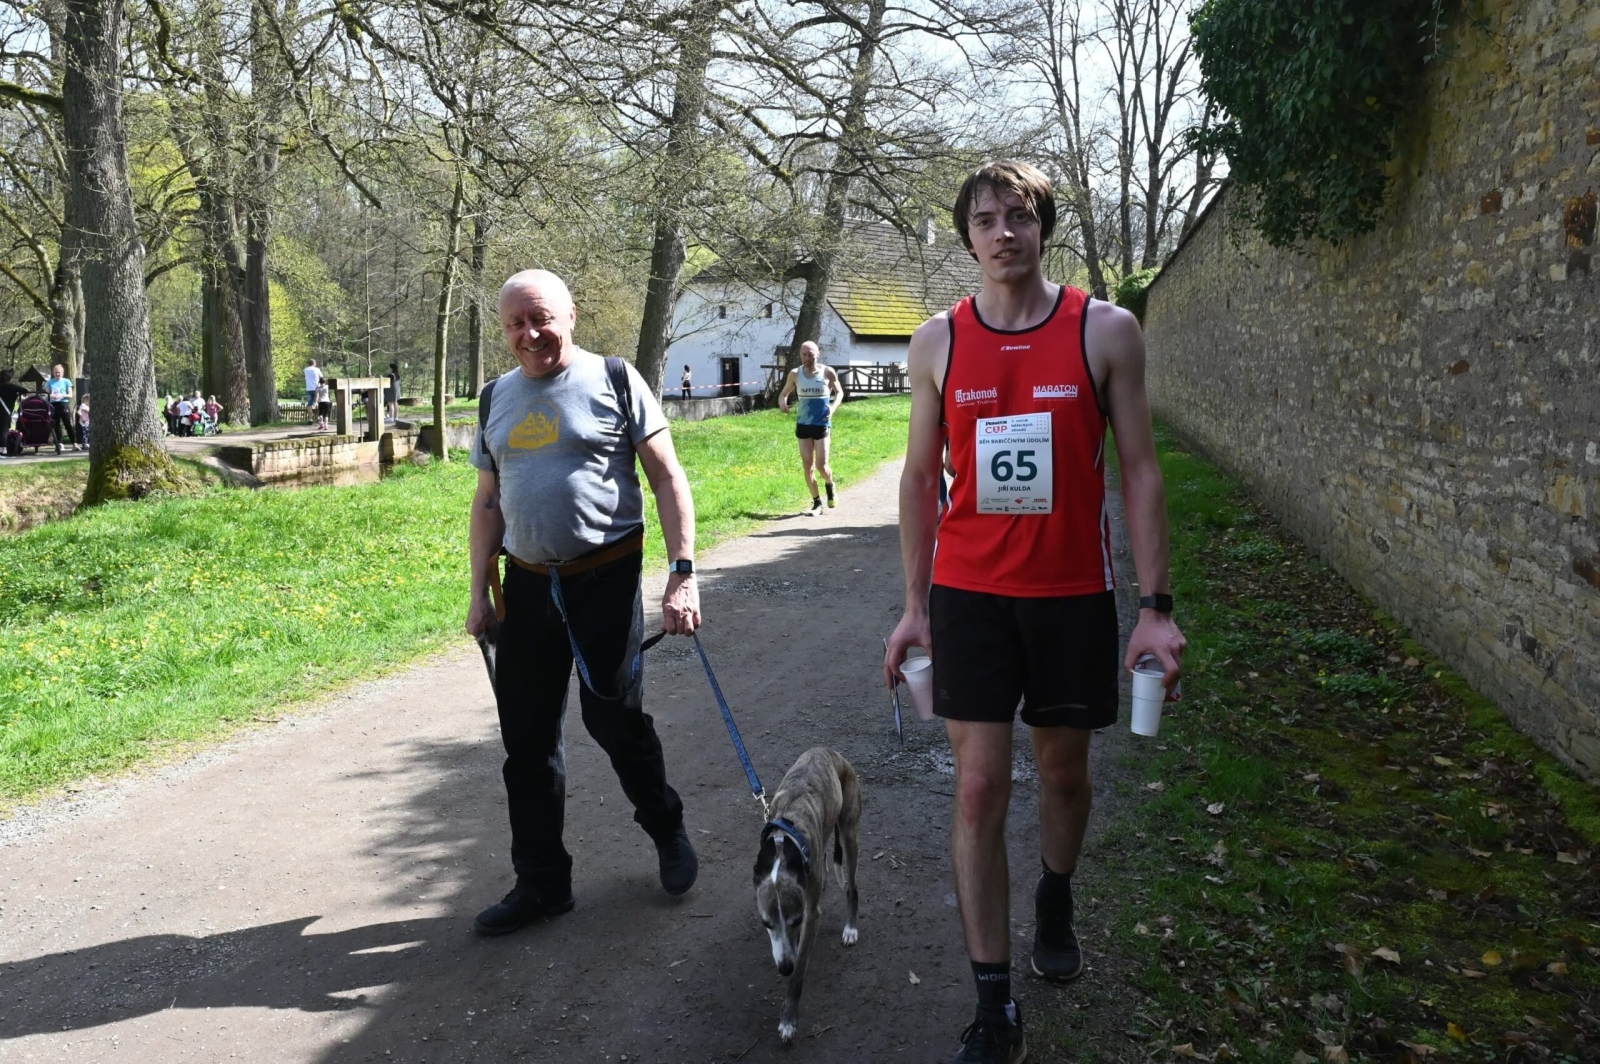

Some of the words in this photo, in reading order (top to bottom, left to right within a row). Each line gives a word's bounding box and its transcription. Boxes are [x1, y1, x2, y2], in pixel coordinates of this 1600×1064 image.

[955, 387, 998, 403] Krakonoš
[985, 425, 1007, 434] CUP
[990, 450, 1038, 482] 65
[997, 484, 1009, 493] JIŘÍ
